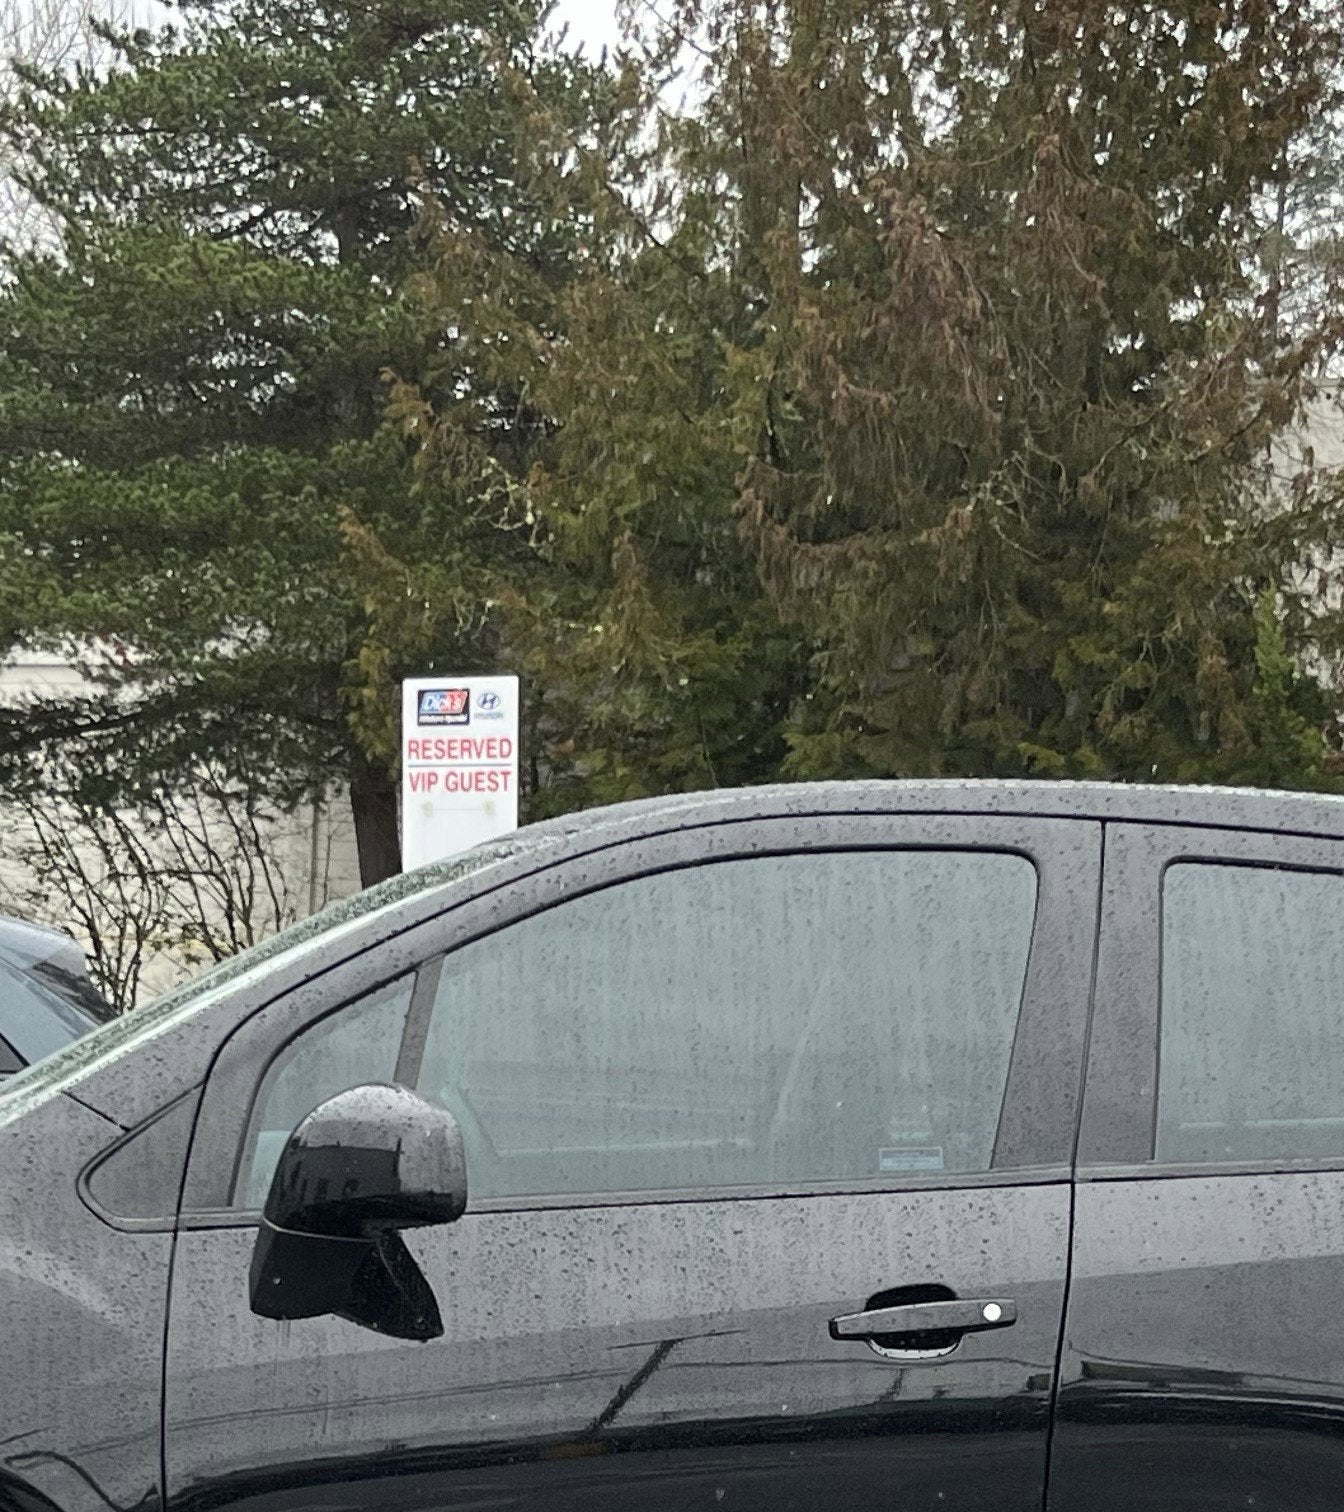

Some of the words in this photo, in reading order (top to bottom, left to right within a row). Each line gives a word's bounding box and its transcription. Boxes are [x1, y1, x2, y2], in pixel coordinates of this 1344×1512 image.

[408, 737, 513, 761] RESERVED
[409, 771, 439, 793] VIP
[445, 770, 512, 793] GUEST
